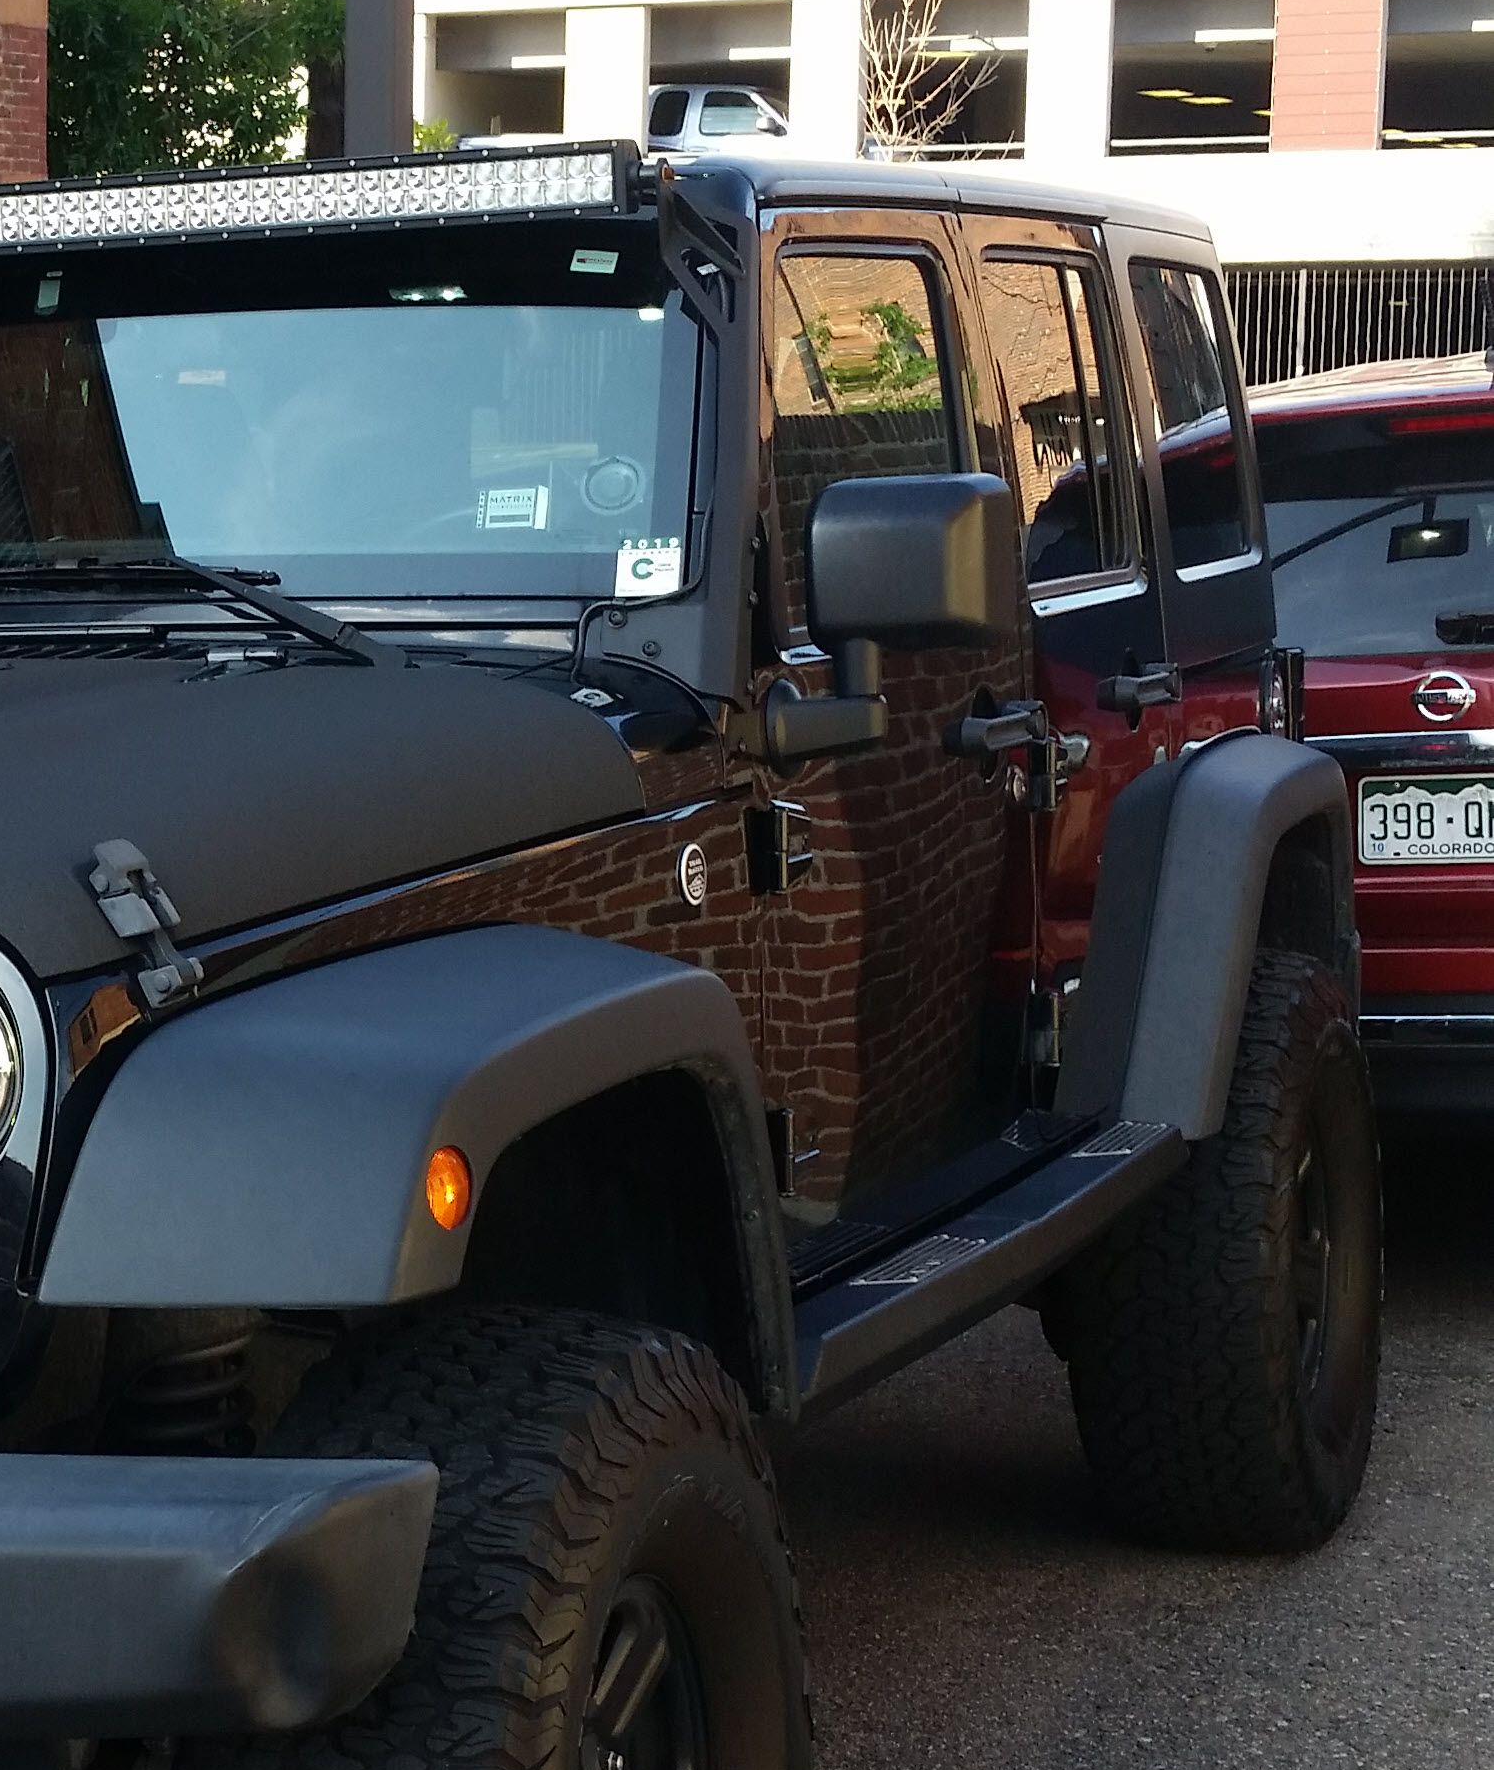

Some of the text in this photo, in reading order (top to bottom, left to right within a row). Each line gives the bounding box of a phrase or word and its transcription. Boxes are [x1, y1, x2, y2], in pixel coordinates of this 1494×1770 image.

[489, 495, 533, 504] MATRIX
[622, 537, 679, 550] 2019
[1372, 843, 1494, 856] 10 COLORADO
